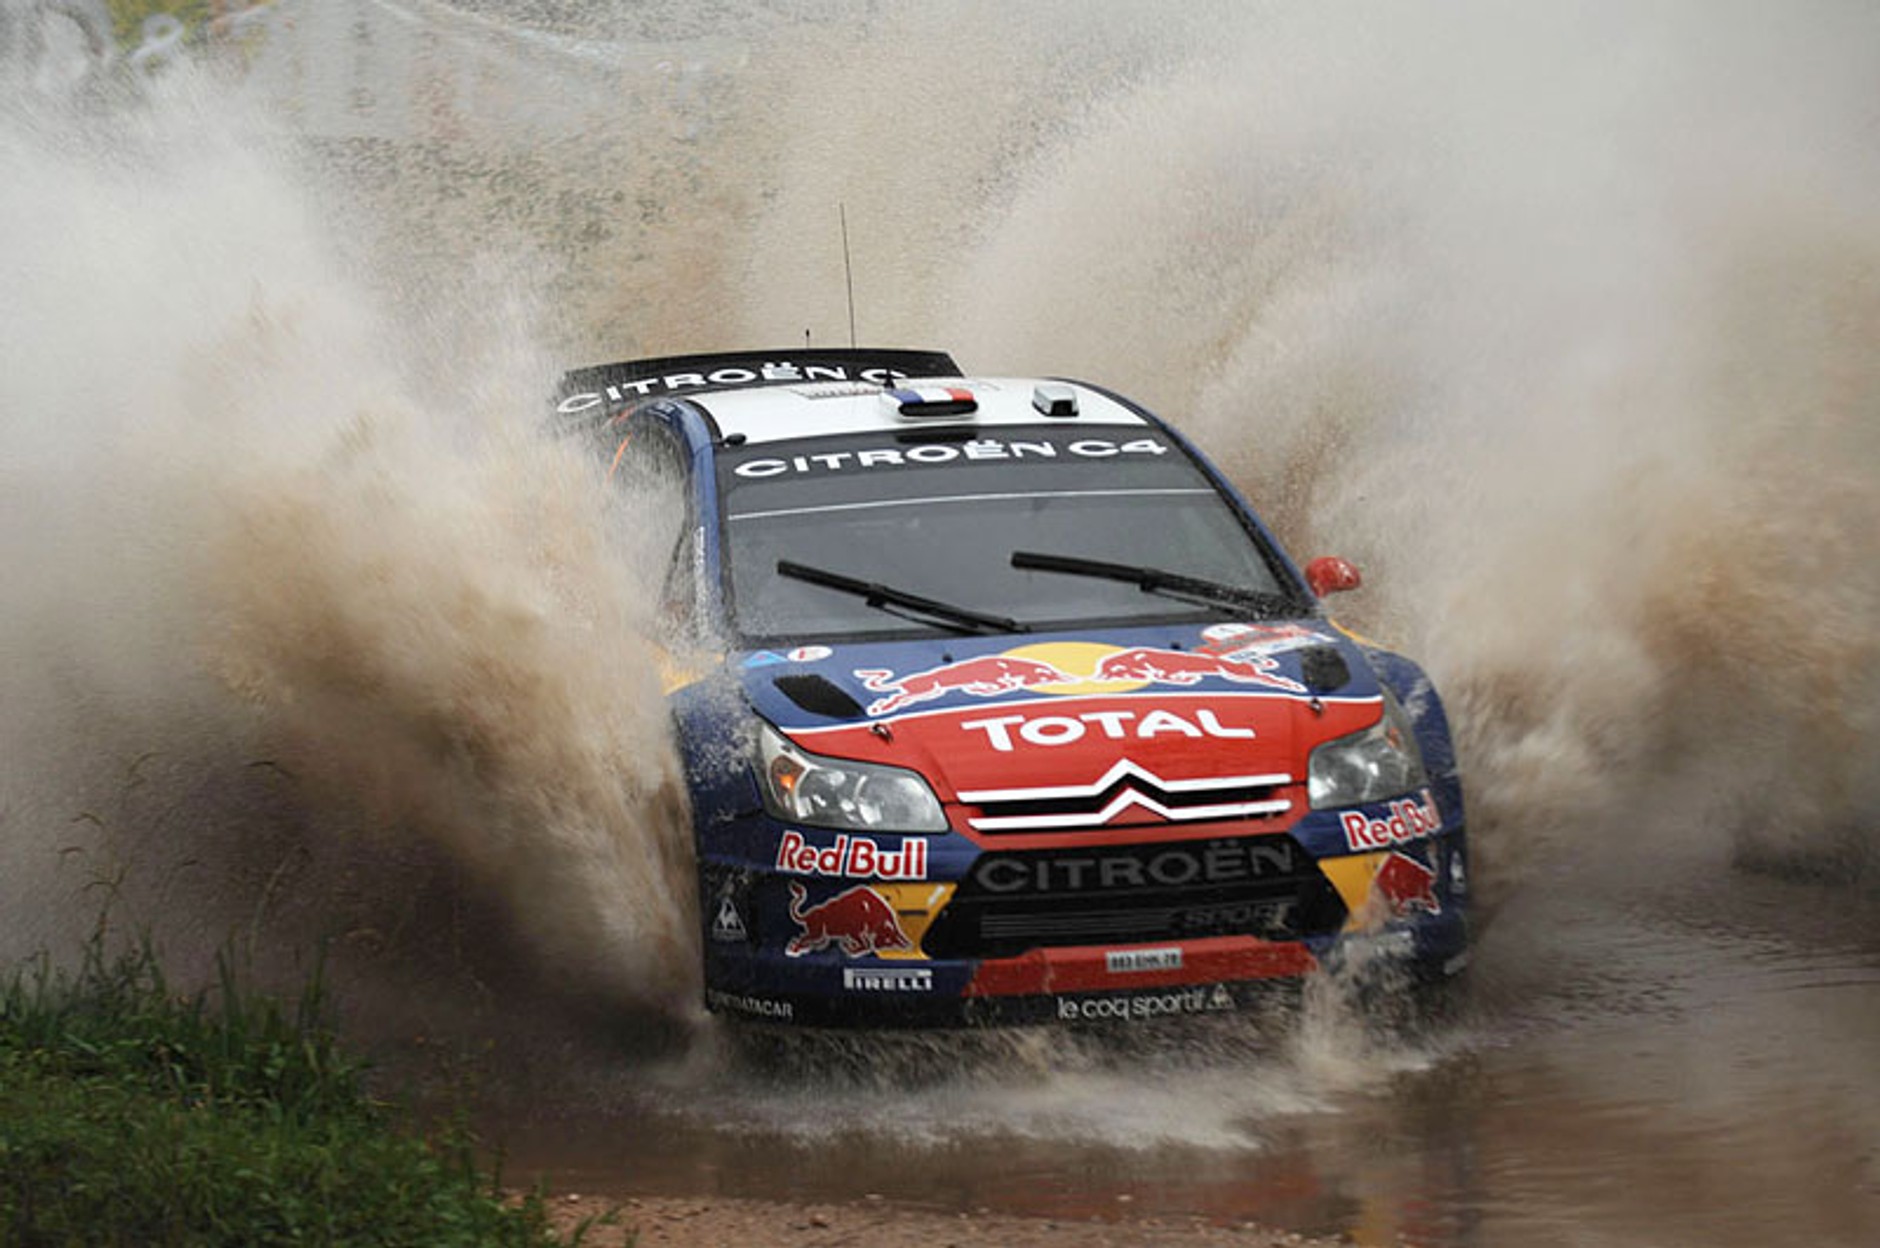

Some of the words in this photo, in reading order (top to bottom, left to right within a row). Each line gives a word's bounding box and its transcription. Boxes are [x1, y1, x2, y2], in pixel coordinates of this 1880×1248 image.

[557, 361, 847, 413] CITROËN
[734, 439, 1058, 478] CITROËN
[1068, 438, 1167, 458] C4
[960, 709, 1256, 752] TOTAL
[1339, 800, 1413, 851] Red
[775, 830, 848, 876] Red
[846, 837, 928, 880] Bull
[976, 839, 1294, 892] CITROËN
[843, 967, 933, 991] PIRELLI
[1057, 996, 1079, 1020] le
[1081, 998, 1130, 1021] coq
[1132, 987, 1206, 1018] sportif
